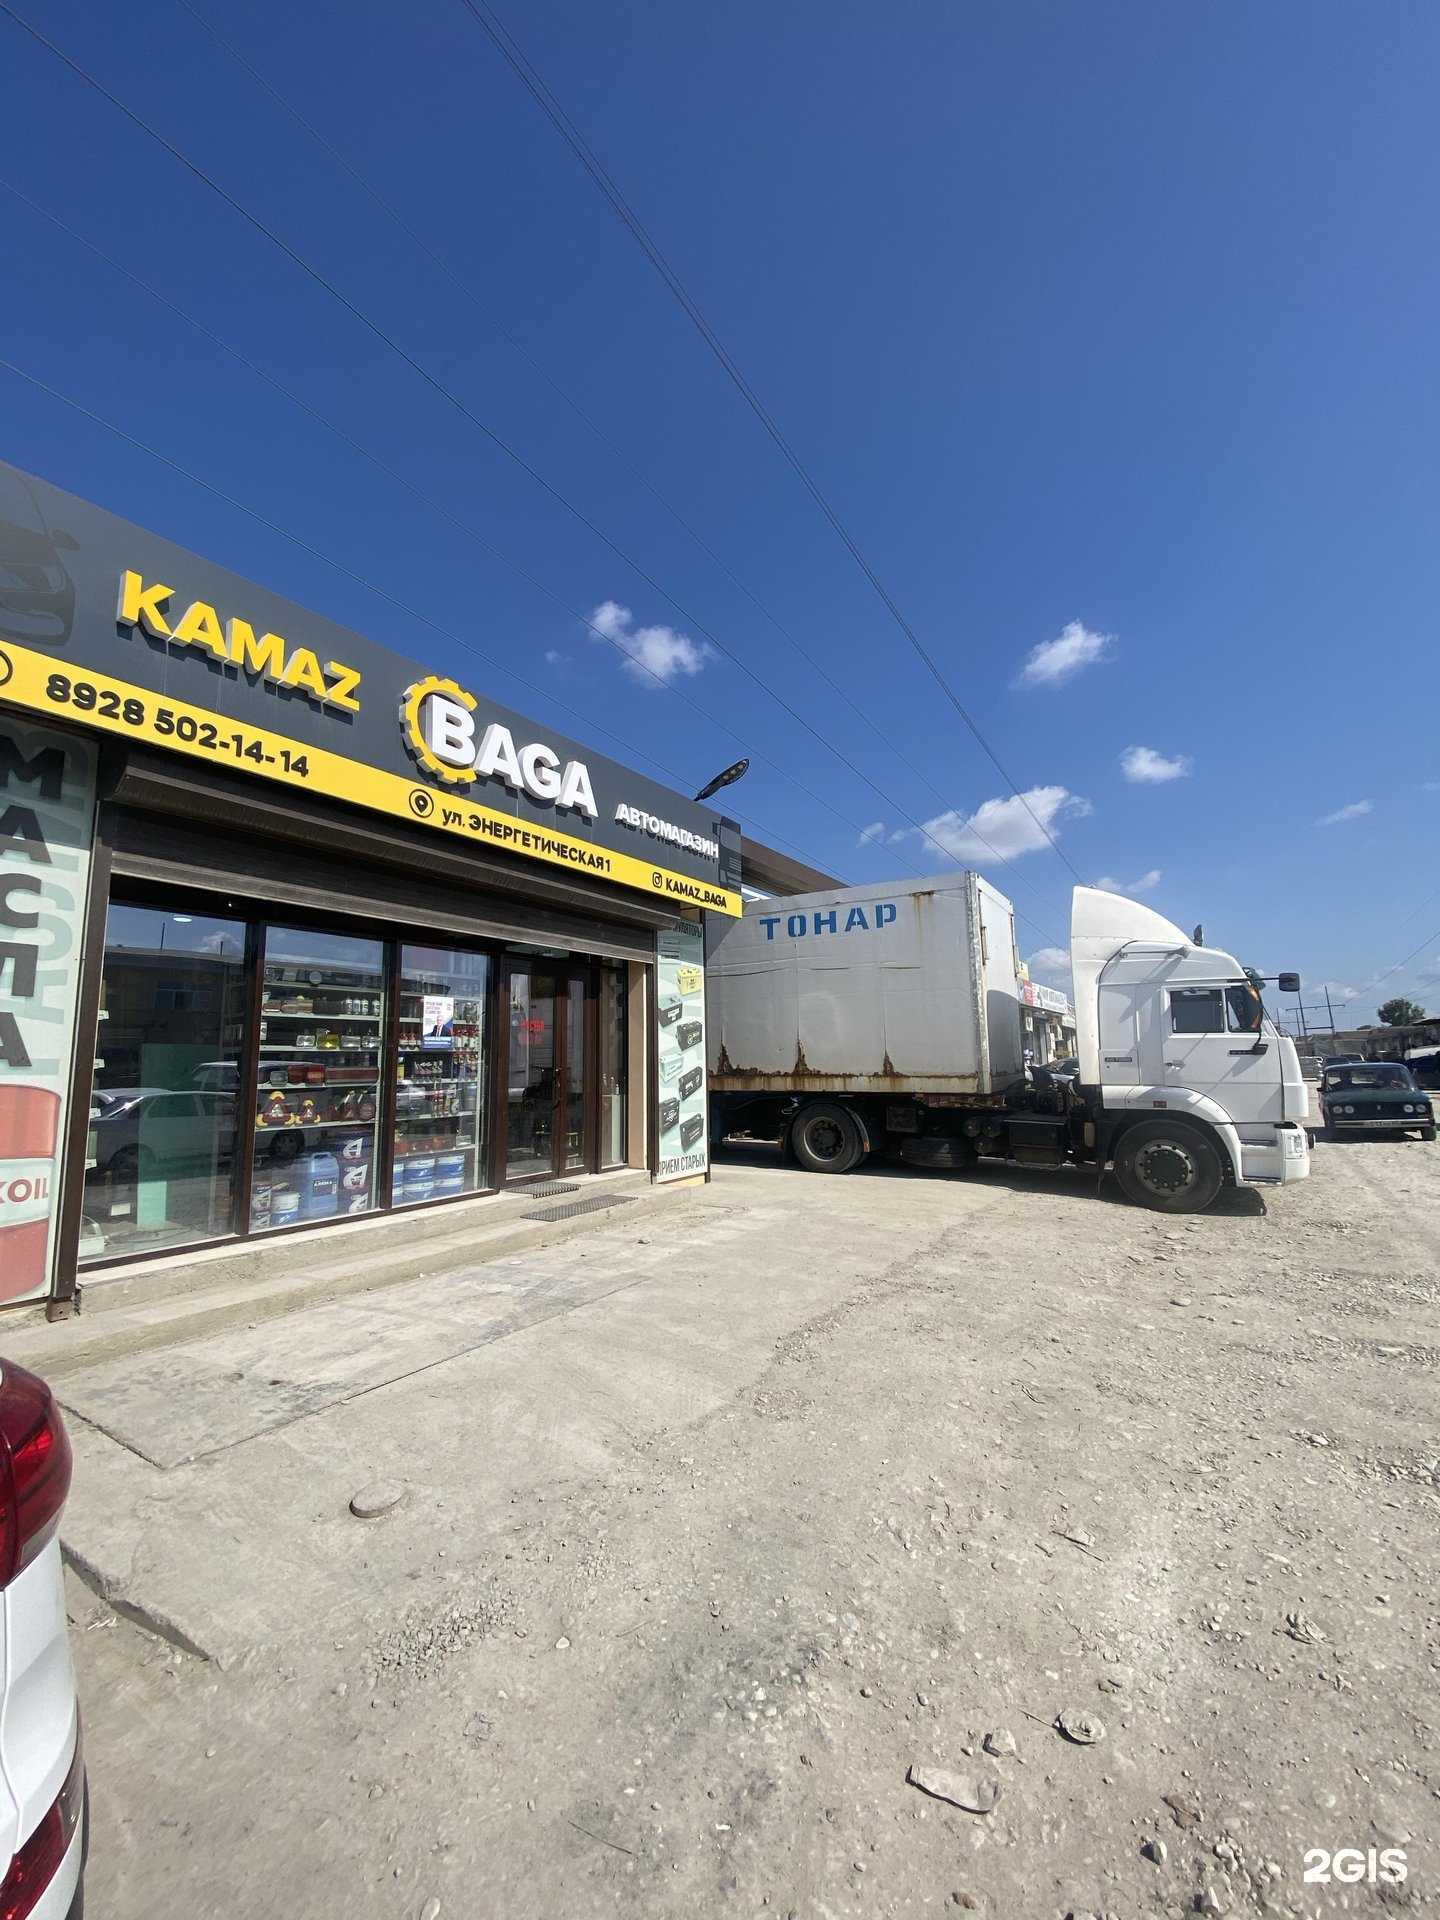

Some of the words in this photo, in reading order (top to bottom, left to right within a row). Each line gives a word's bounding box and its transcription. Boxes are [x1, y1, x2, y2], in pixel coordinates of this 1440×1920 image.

[117, 569, 361, 711] KAMAZ
[46, 673, 145, 726] 8928
[154, 707, 309, 778] 502-14-14
[426, 694, 599, 818] BAGA
[442, 808, 466, 827] ул.
[614, 803, 719, 859] АВТОМАГАЗИН
[666, 878, 727, 908] KAMAZ_BAGA
[759, 903, 897, 941] ТОНАР
